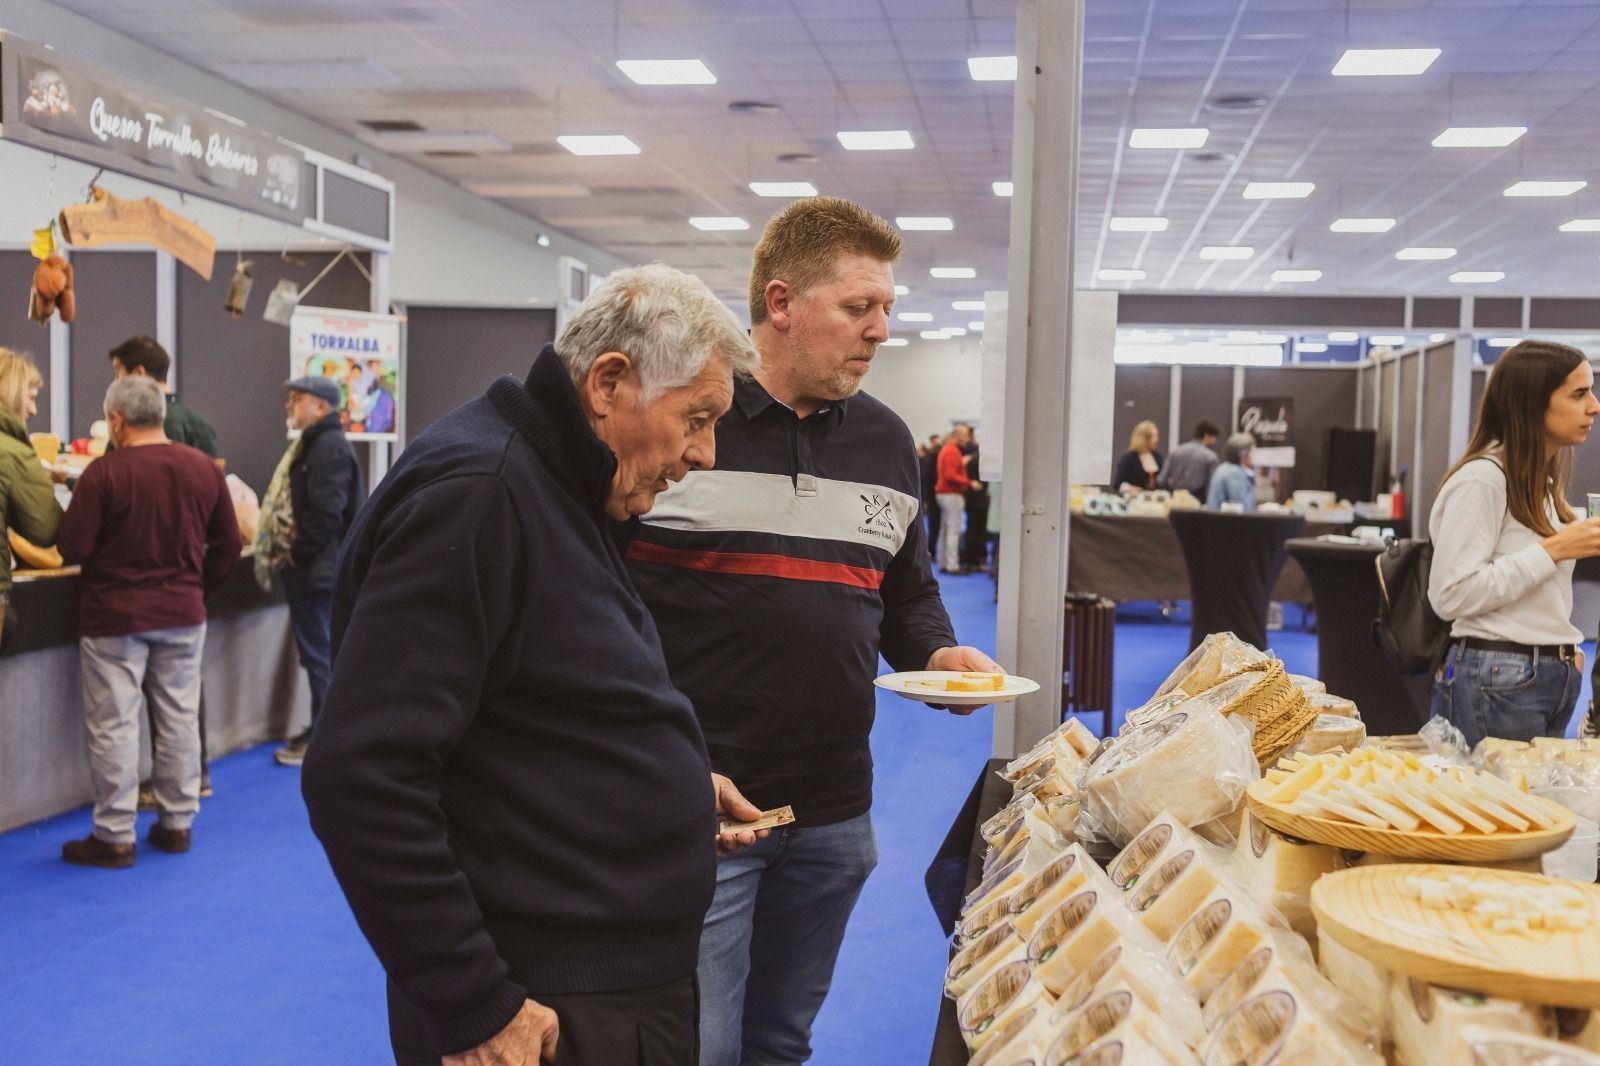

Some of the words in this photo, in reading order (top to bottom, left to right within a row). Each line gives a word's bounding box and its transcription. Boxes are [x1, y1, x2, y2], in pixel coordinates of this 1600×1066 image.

[145, 112, 203, 158] Torralba
[311, 333, 379, 352] TORRALBA
[858, 526, 880, 538] Cranberry
